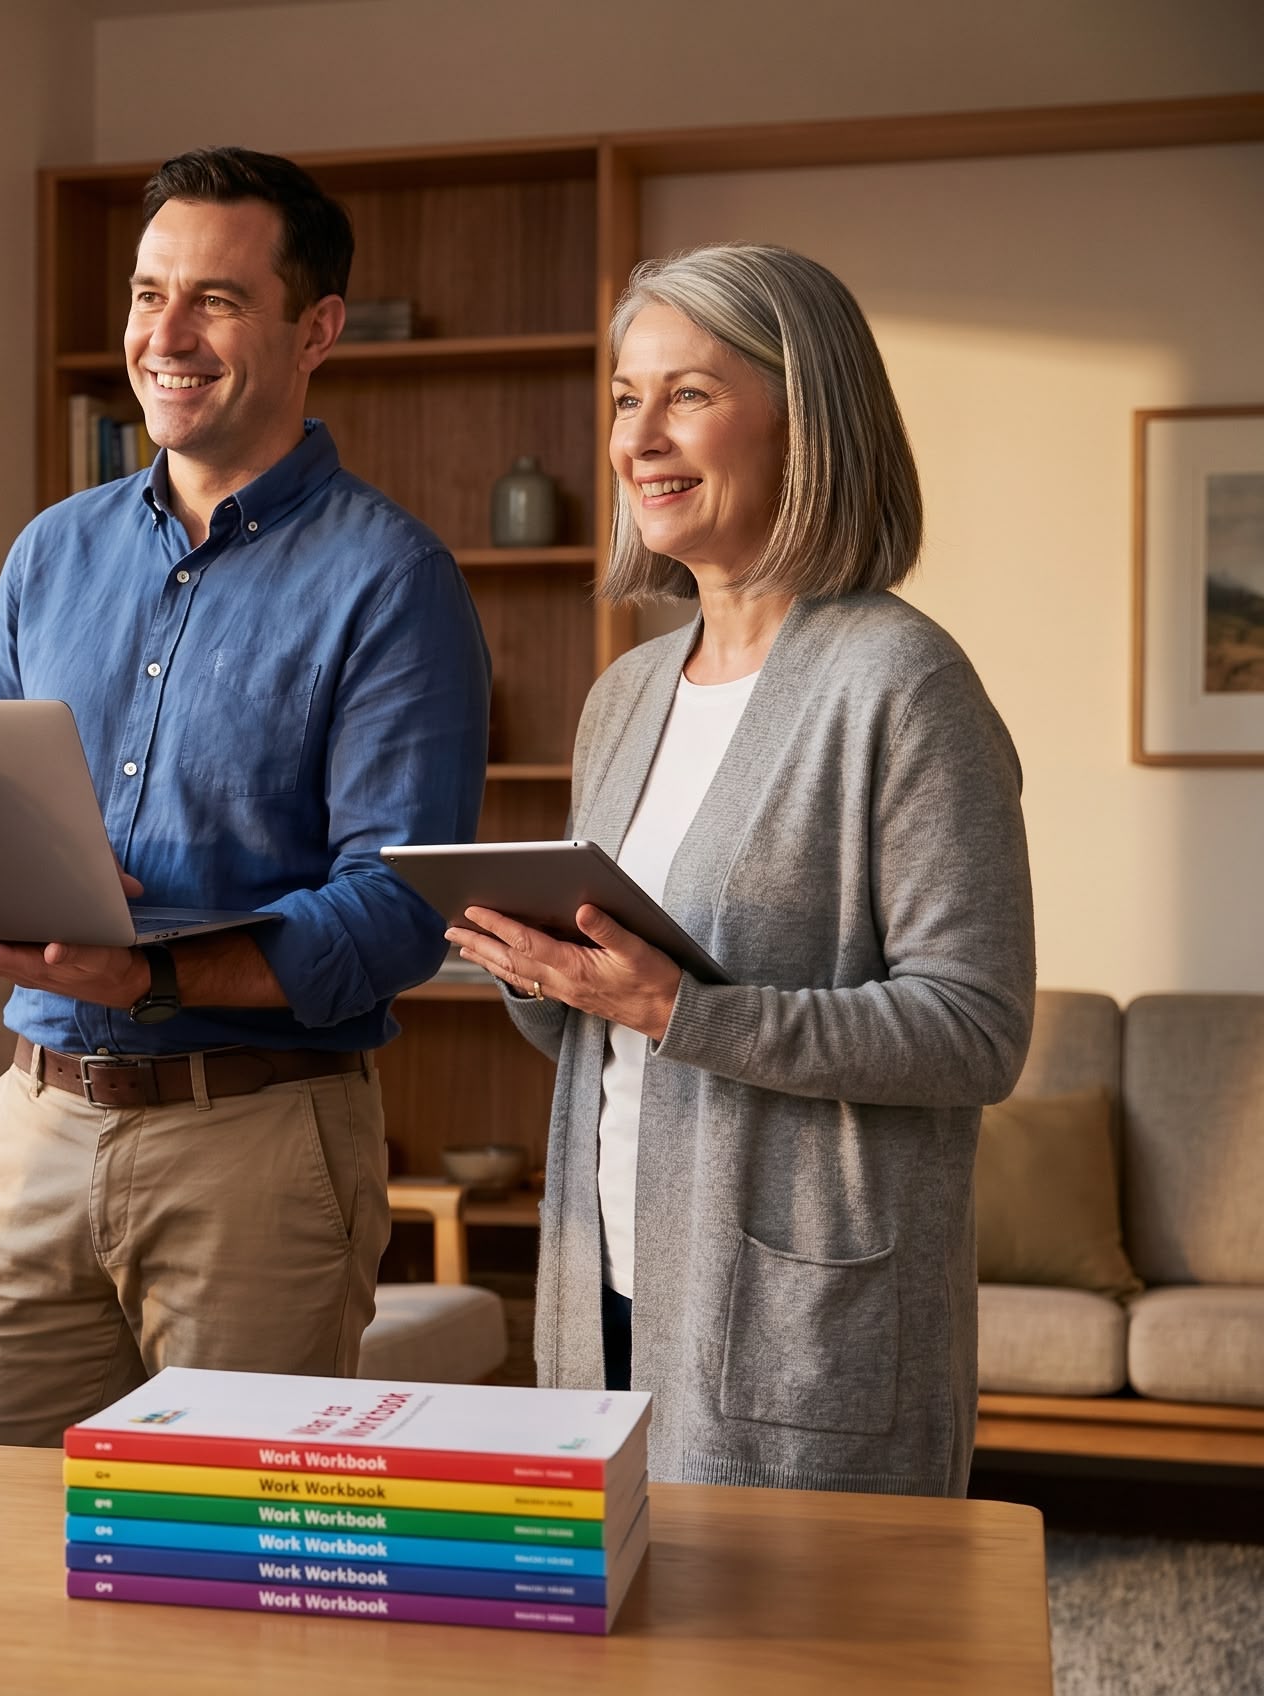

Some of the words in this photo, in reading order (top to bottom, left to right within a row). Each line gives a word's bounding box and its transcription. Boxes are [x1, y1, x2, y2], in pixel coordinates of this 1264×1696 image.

[259, 1449, 301, 1466] Work
[305, 1452, 387, 1471] Workbook
[259, 1478, 300, 1493] Work
[305, 1481, 386, 1499] Workbook
[259, 1506, 300, 1524] Work
[304, 1509, 387, 1529] Workbook
[259, 1534, 301, 1551] Work
[304, 1537, 388, 1557] Workbook
[259, 1563, 301, 1580] Work
[304, 1566, 388, 1586] Workbook
[259, 1591, 301, 1608] Work
[305, 1594, 388, 1614] Workbook
